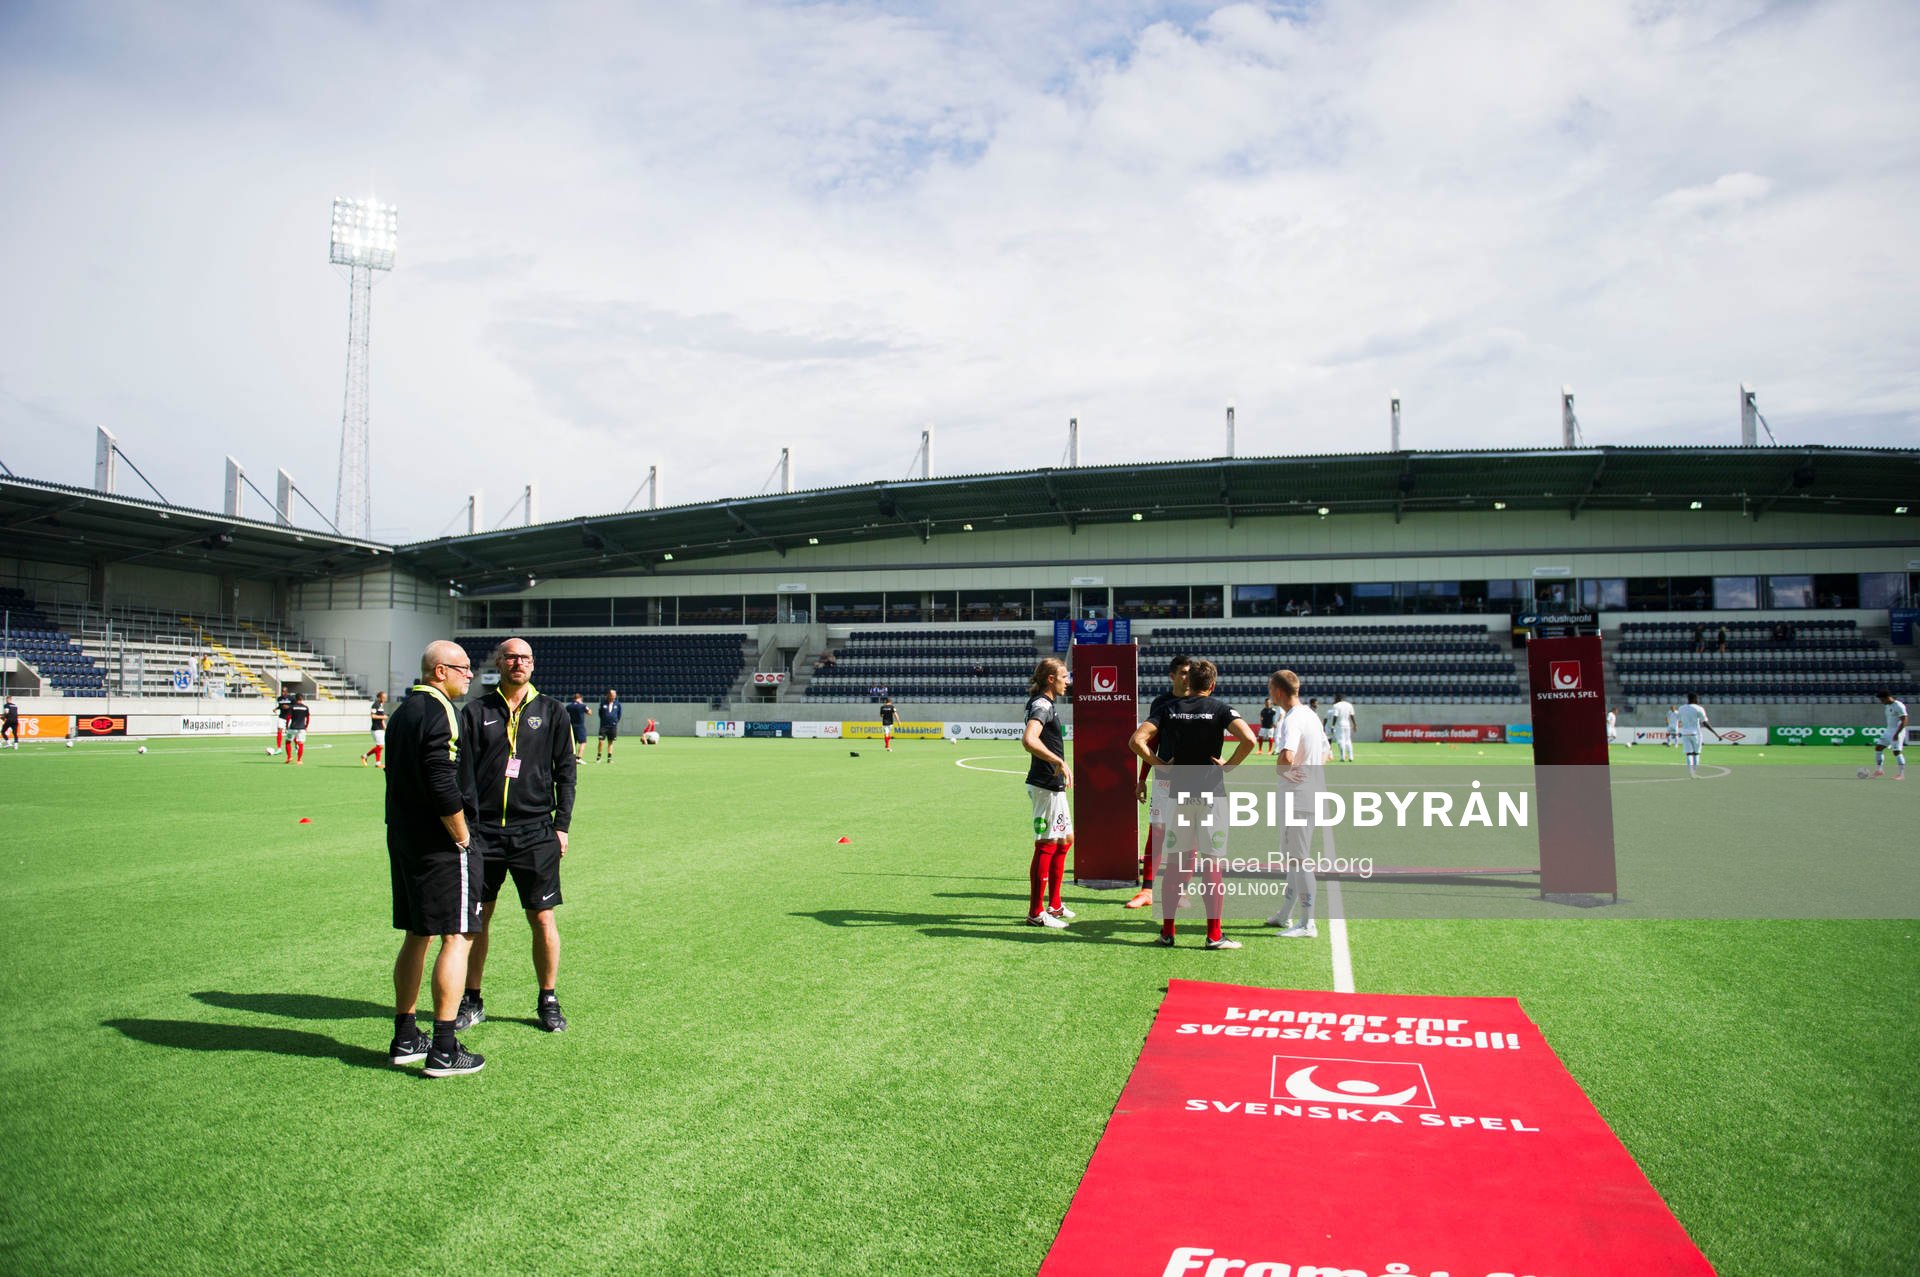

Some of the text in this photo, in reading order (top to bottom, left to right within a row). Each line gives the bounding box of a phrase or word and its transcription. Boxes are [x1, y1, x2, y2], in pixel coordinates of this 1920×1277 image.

[1537, 690, 1598, 700] SVENSKA SPEL
[182, 718, 224, 731] Magasinet
[970, 726, 1024, 736] Volkswagen
[1777, 727, 1813, 738] coop
[1819, 727, 1855, 738] coop
[1862, 727, 1887, 736] coo
[1176, 1023, 1521, 1050] svensk fotboll!
[1185, 1099, 1540, 1133] SVENSKA SPEL
